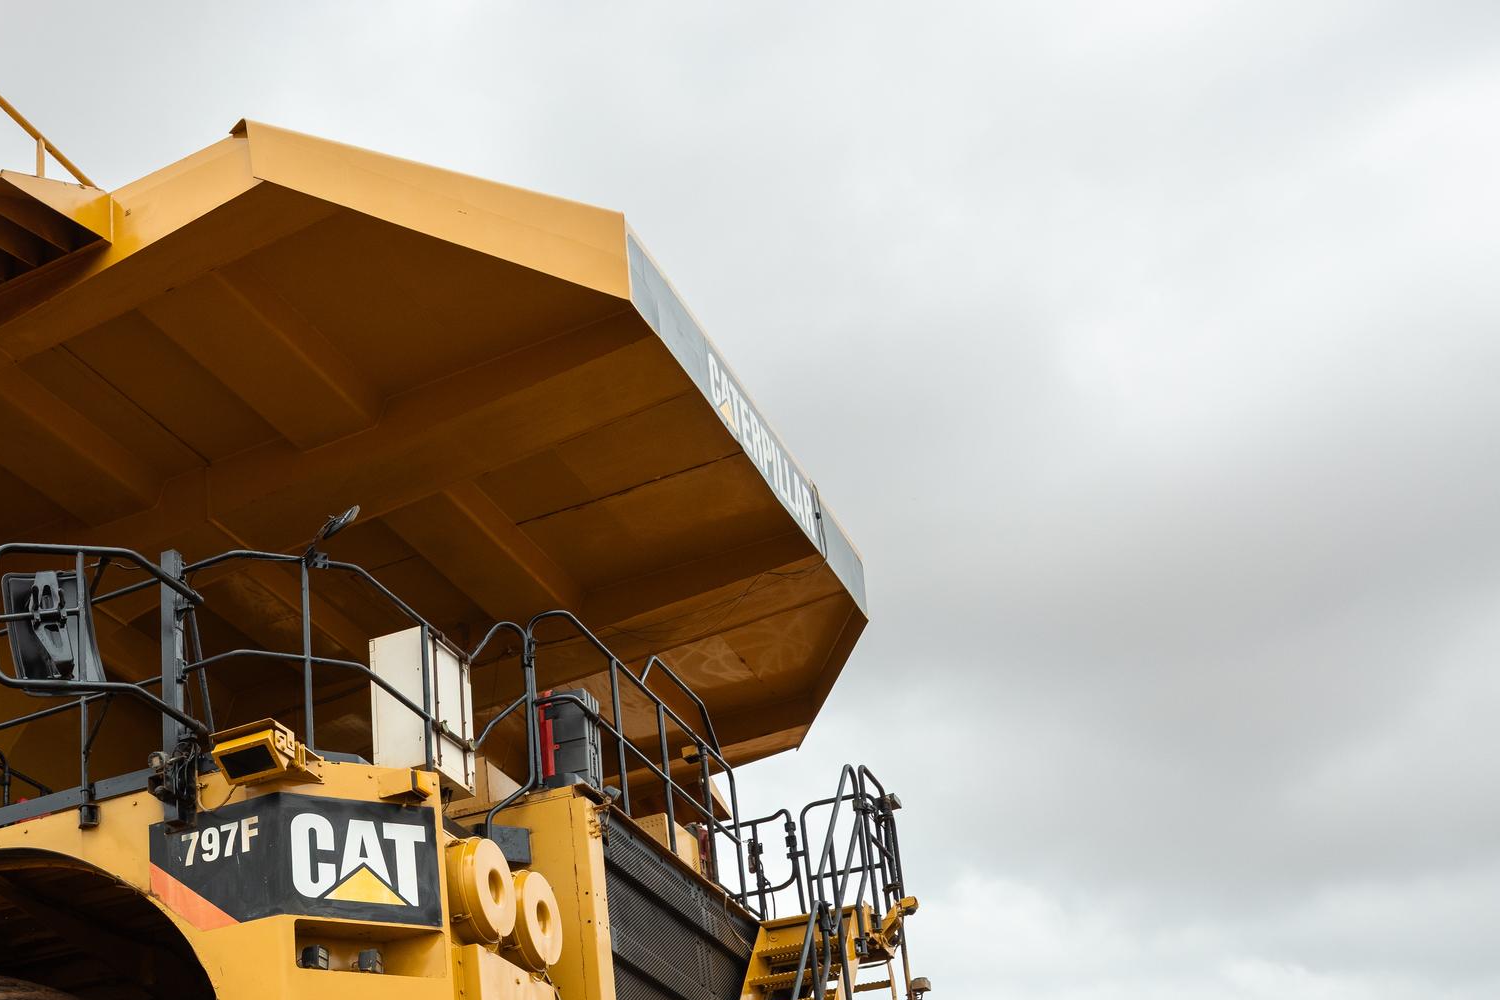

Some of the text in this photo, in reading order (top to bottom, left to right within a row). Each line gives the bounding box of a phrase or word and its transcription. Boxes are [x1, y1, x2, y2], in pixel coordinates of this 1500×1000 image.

[708, 353, 816, 538] CATERPILLAR
[181, 816, 259, 867] 797F
[290, 813, 426, 907] CAT
